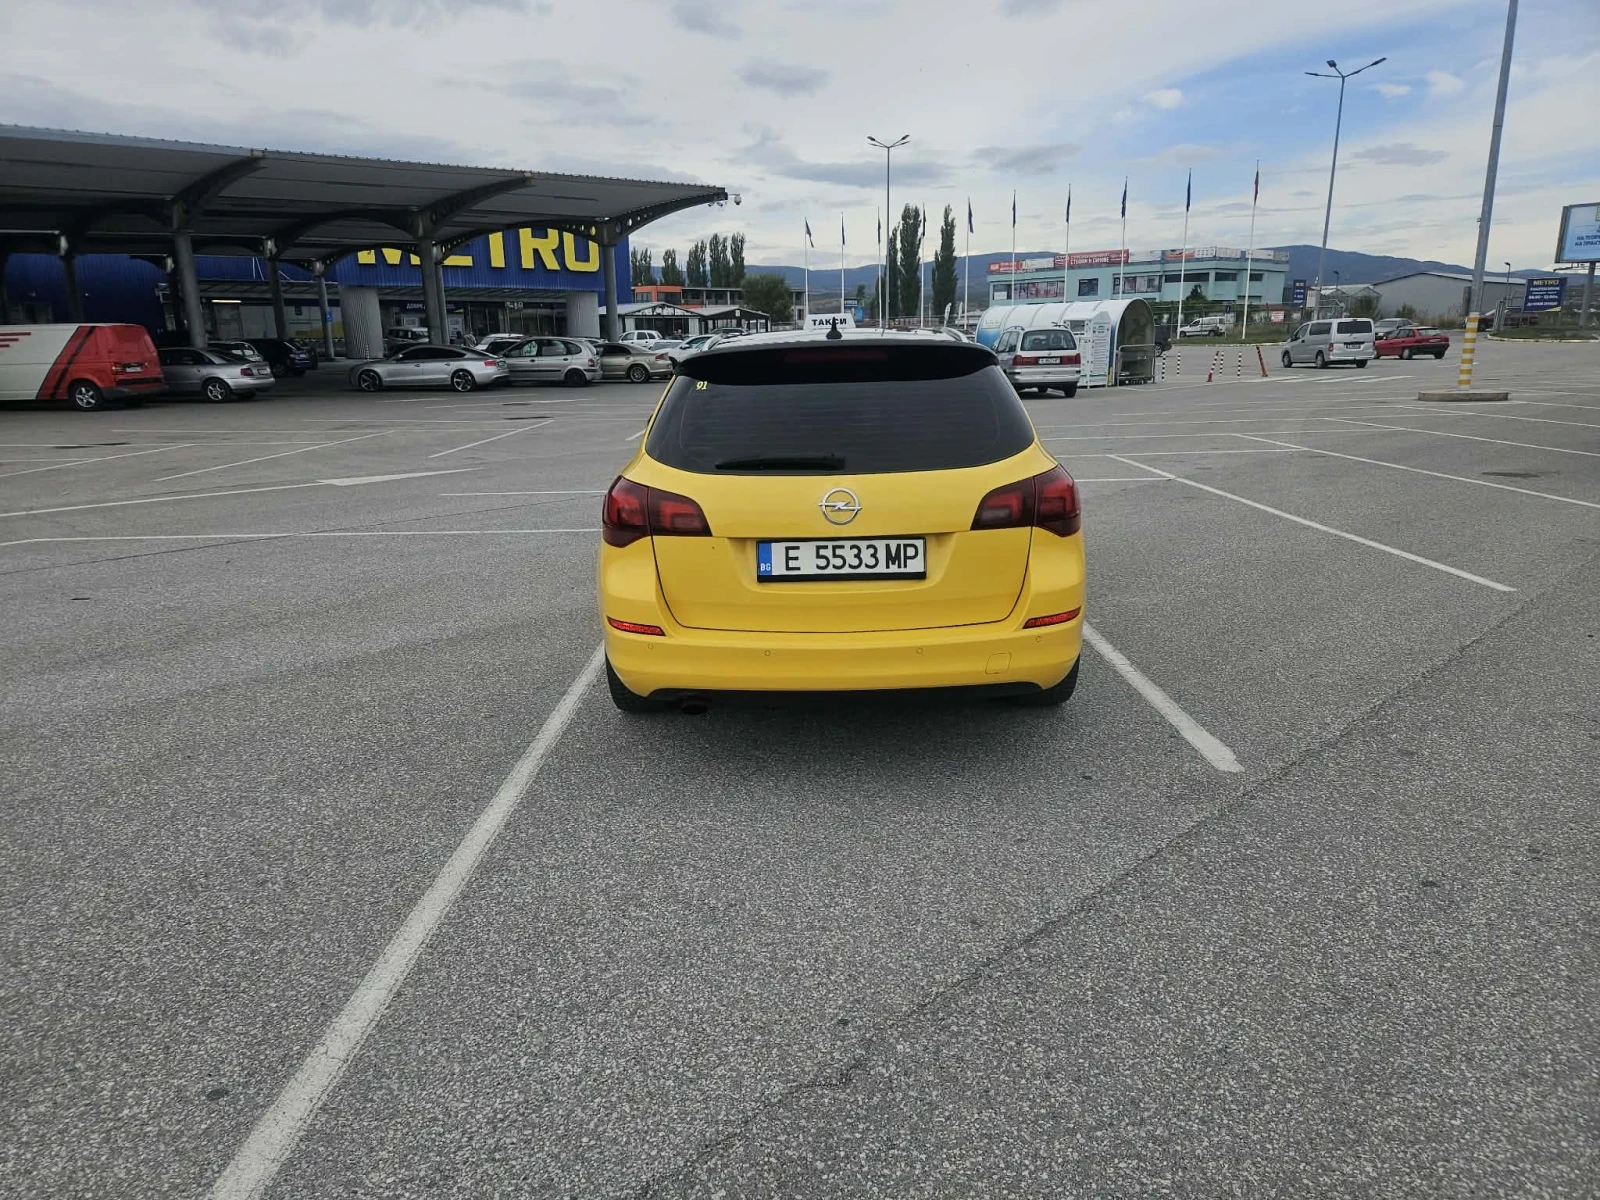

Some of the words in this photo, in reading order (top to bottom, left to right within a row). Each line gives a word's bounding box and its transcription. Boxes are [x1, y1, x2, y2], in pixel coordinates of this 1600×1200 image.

[696, 381, 708, 390] 91
[785, 546, 801, 571] E
[815, 544, 879, 570] 5533
[885, 543, 919, 569] MP
[760, 563, 771, 571] BG
